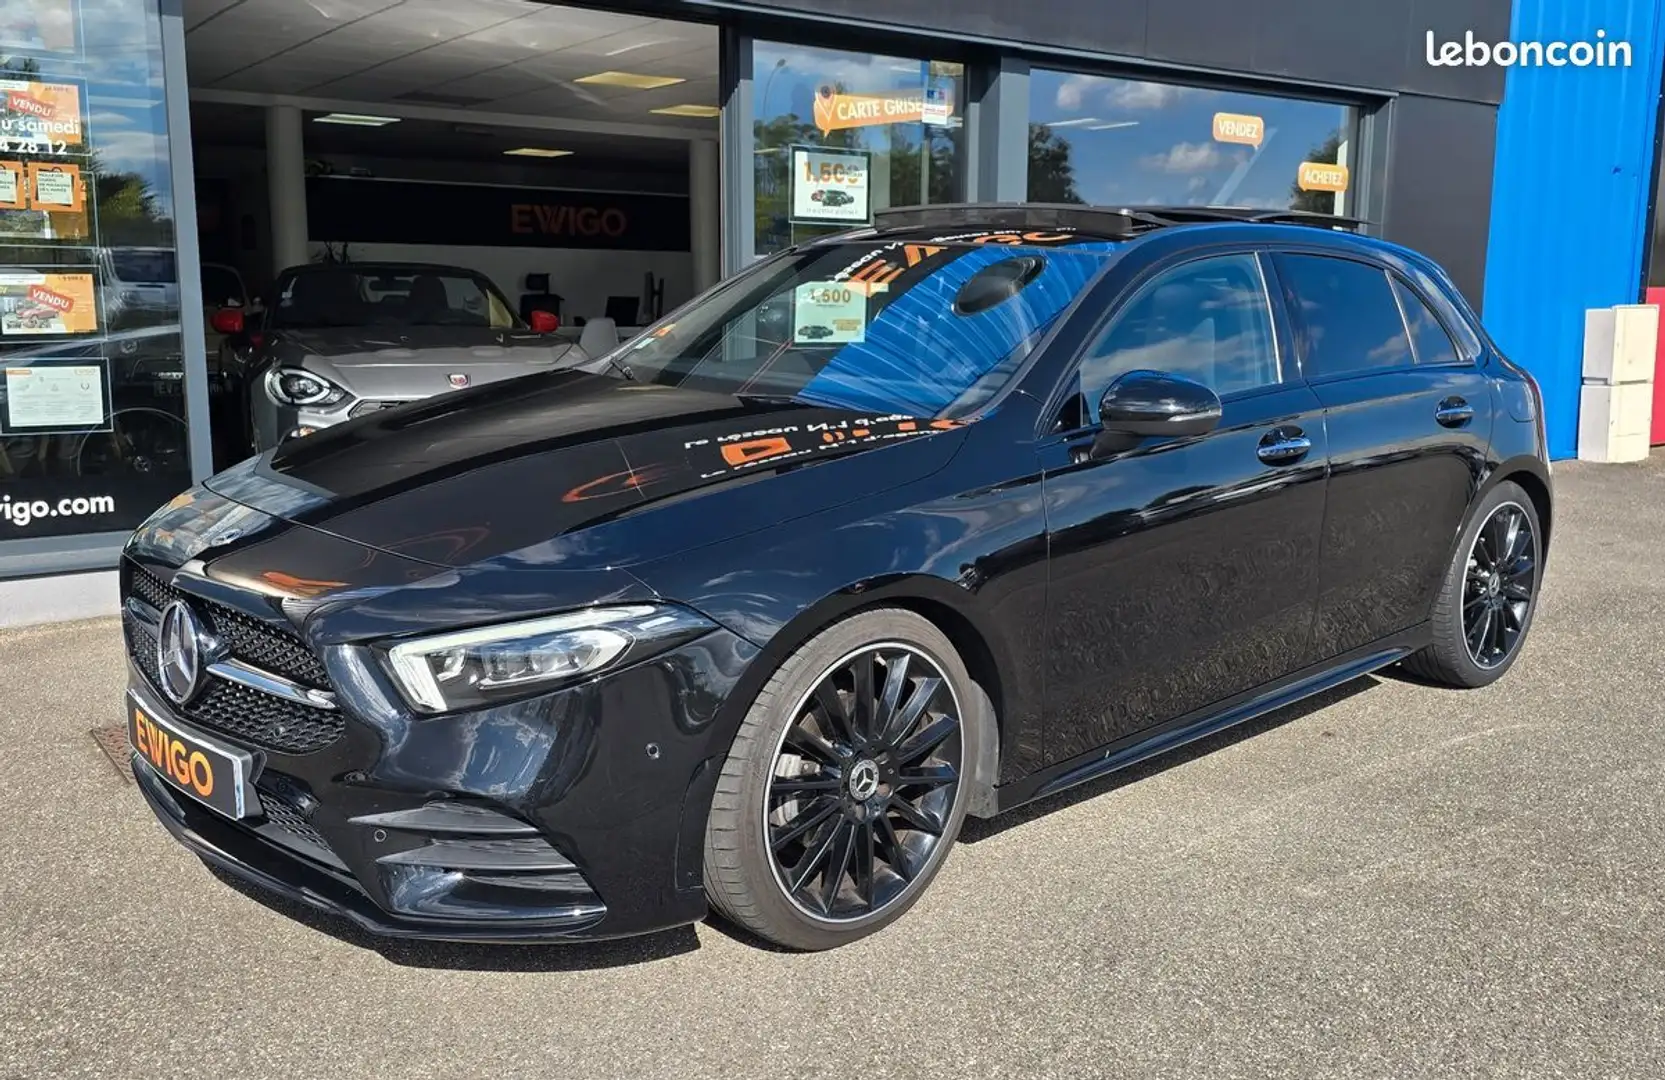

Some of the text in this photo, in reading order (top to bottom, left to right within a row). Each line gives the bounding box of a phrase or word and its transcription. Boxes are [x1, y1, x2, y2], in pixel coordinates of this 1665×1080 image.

[12, 96, 53, 117] VENDU
[837, 100, 881, 121] CARTE
[18, 119, 79, 134] samedi
[1218, 120, 1259, 138] VENDEZ
[17, 141, 39, 154] 28
[1303, 170, 1344, 186] ACHETEZ
[510, 203, 628, 237] EWIGO
[33, 288, 69, 309] VENDU
[134, 707, 214, 797] EWIGO
